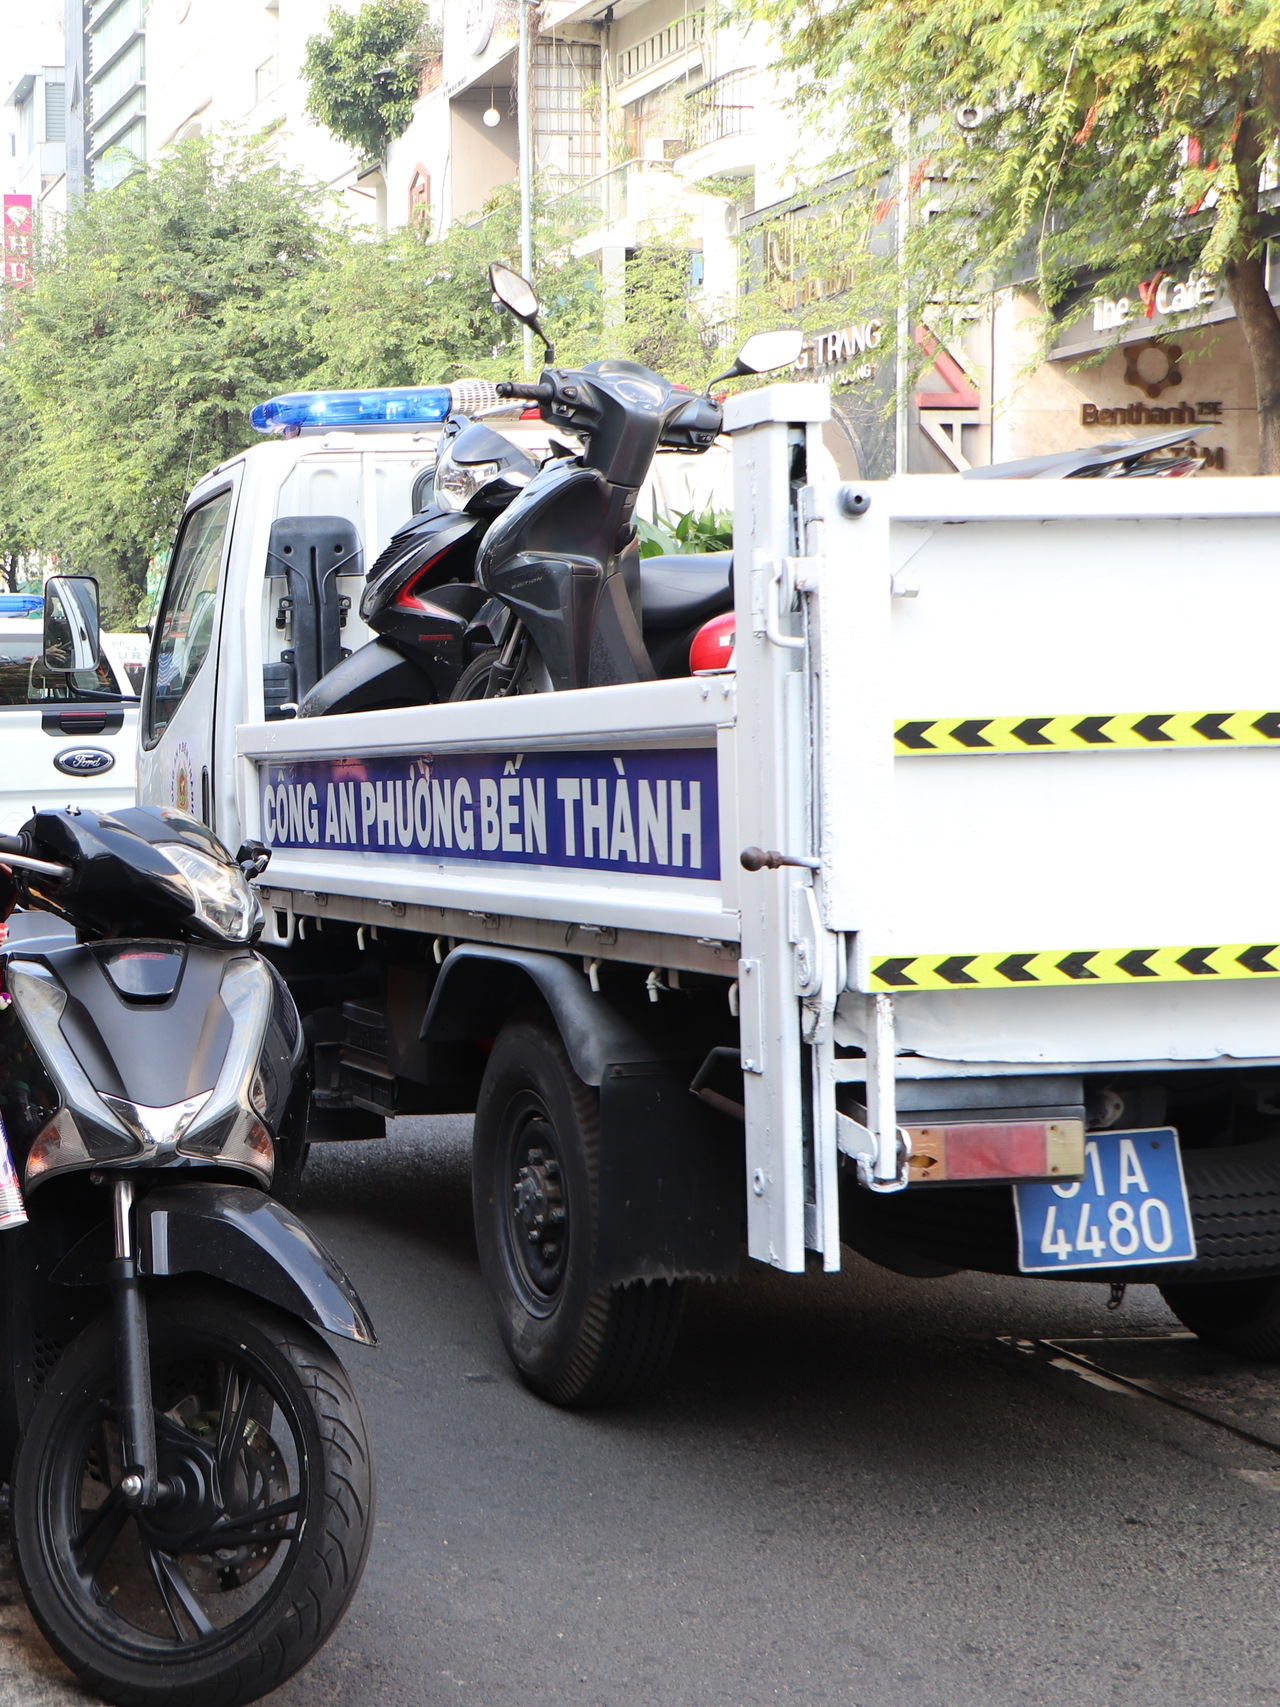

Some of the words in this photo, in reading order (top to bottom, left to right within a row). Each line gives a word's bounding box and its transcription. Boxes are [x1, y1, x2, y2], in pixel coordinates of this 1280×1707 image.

[814, 320, 881, 364] TRANG
[1081, 402, 1195, 426] Benthanh
[73, 754, 101, 767] Ford
[263, 770, 319, 844] CÔNG
[325, 781, 358, 845] AN
[361, 760, 475, 851] PHƯỜNG
[479, 754, 548, 855] BẾN
[556, 757, 702, 869] THÀNH
[119, 952, 167, 961] HONDA
[1052, 1138, 1149, 1199] 1A
[1040, 1198, 1173, 1261] 4480
